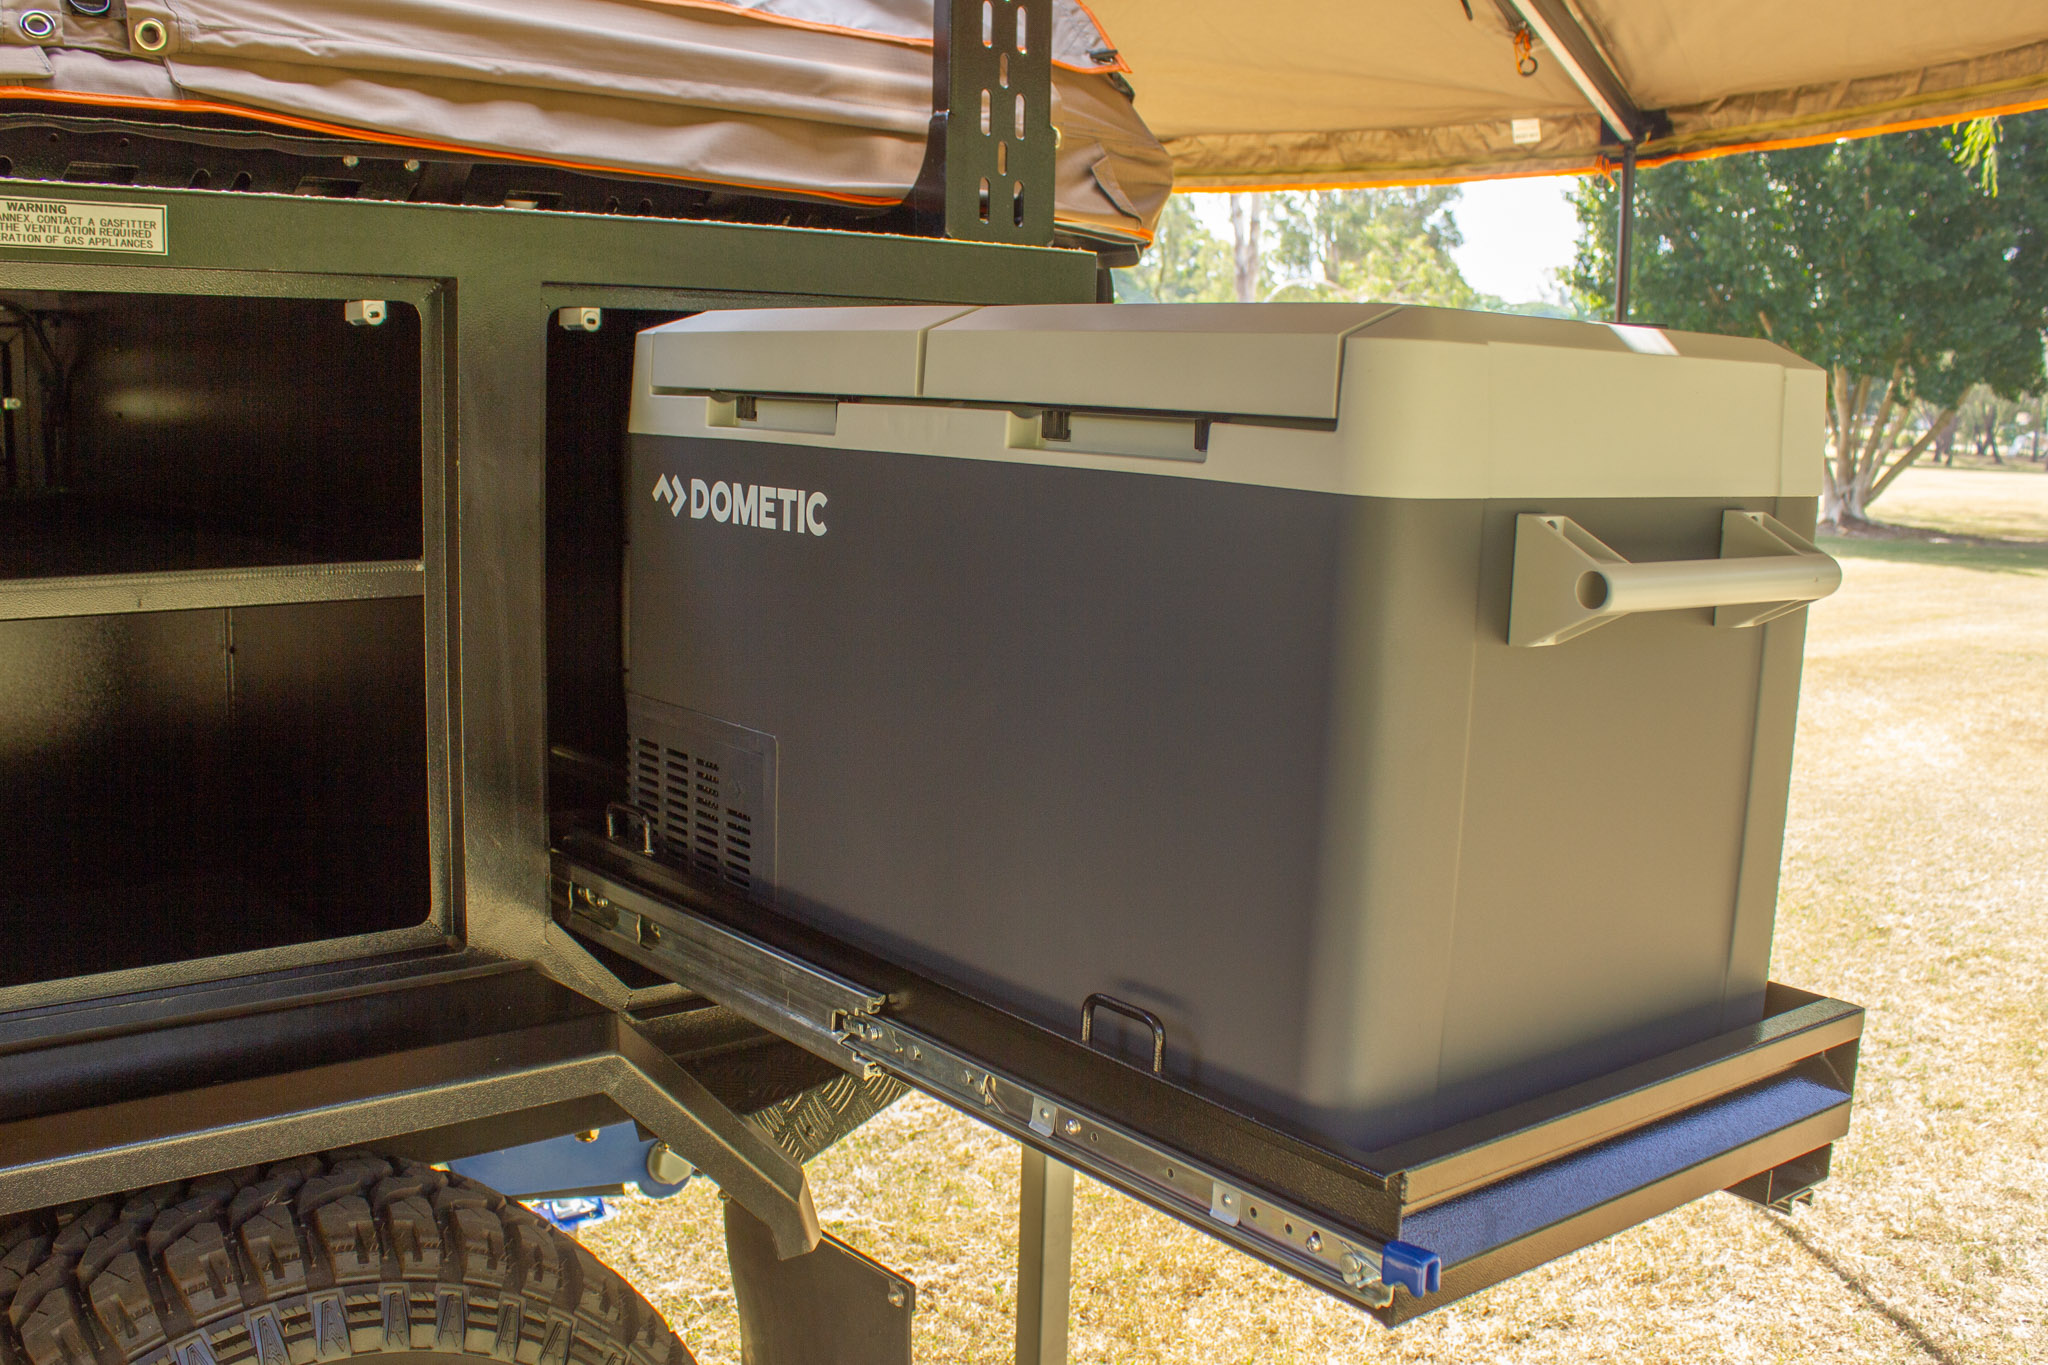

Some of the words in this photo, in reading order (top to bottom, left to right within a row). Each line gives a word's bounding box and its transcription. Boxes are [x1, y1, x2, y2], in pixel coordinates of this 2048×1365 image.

[6, 201, 67, 214] WARNING
[0, 222, 20, 232] THE
[24, 223, 96, 236] VENTILATION
[99, 228, 152, 239] REQUIRED
[36, 215, 83, 226] CONTACT
[88, 217, 95, 227] A
[99, 218, 157, 230] GASFITTER
[0, 232, 42, 243] RATION
[45, 235, 59, 244] OF
[64, 236, 85, 246] GAS
[88, 237, 154, 249] APPLIANCES
[690, 478, 828, 537] DOMETIC
